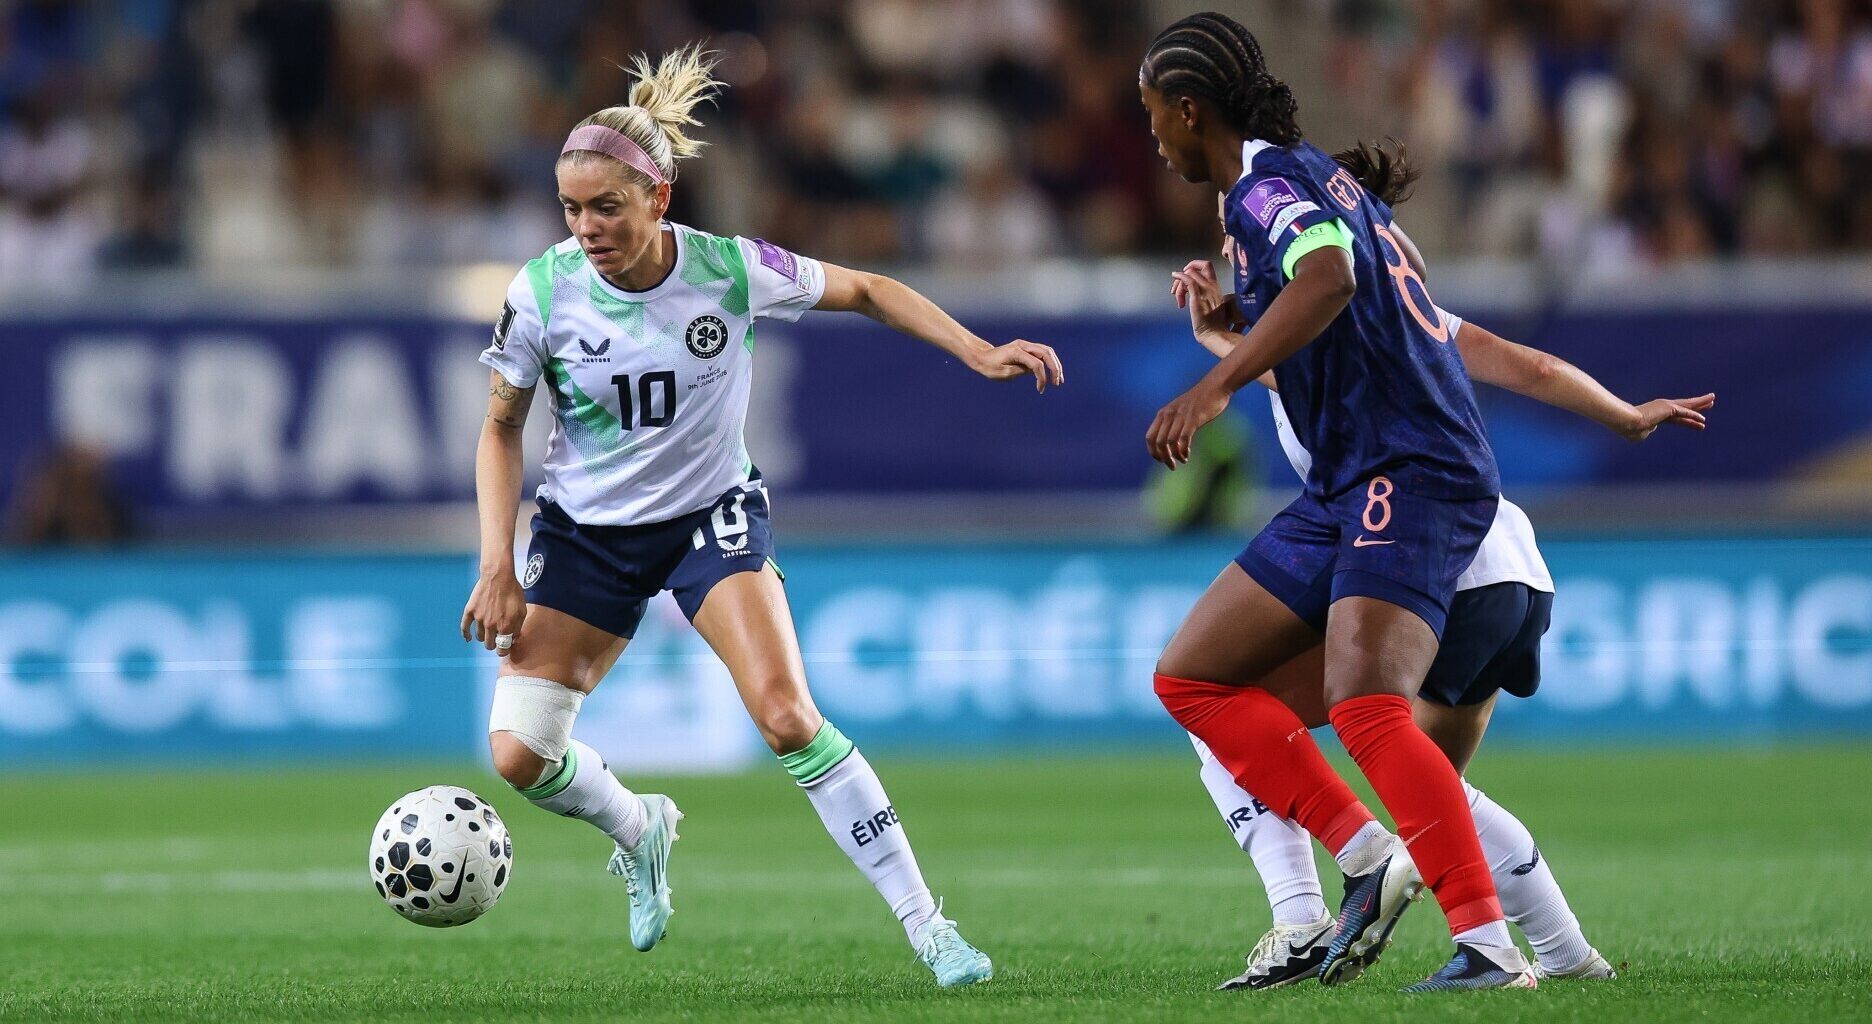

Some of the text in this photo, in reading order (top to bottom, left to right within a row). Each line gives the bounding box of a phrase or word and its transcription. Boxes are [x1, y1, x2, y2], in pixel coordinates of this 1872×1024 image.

[1374, 223, 1448, 343] 8
[687, 316, 724, 334] IRELAND
[611, 370, 677, 431] 10
[696, 367, 721, 382] FRANCE
[699, 376, 715, 388] JUNE
[1362, 476, 1393, 532] 8
[0, 602, 397, 733] COLE
[1493, 572, 1872, 712] GRIC
[850, 805, 899, 848] ÉIRE
